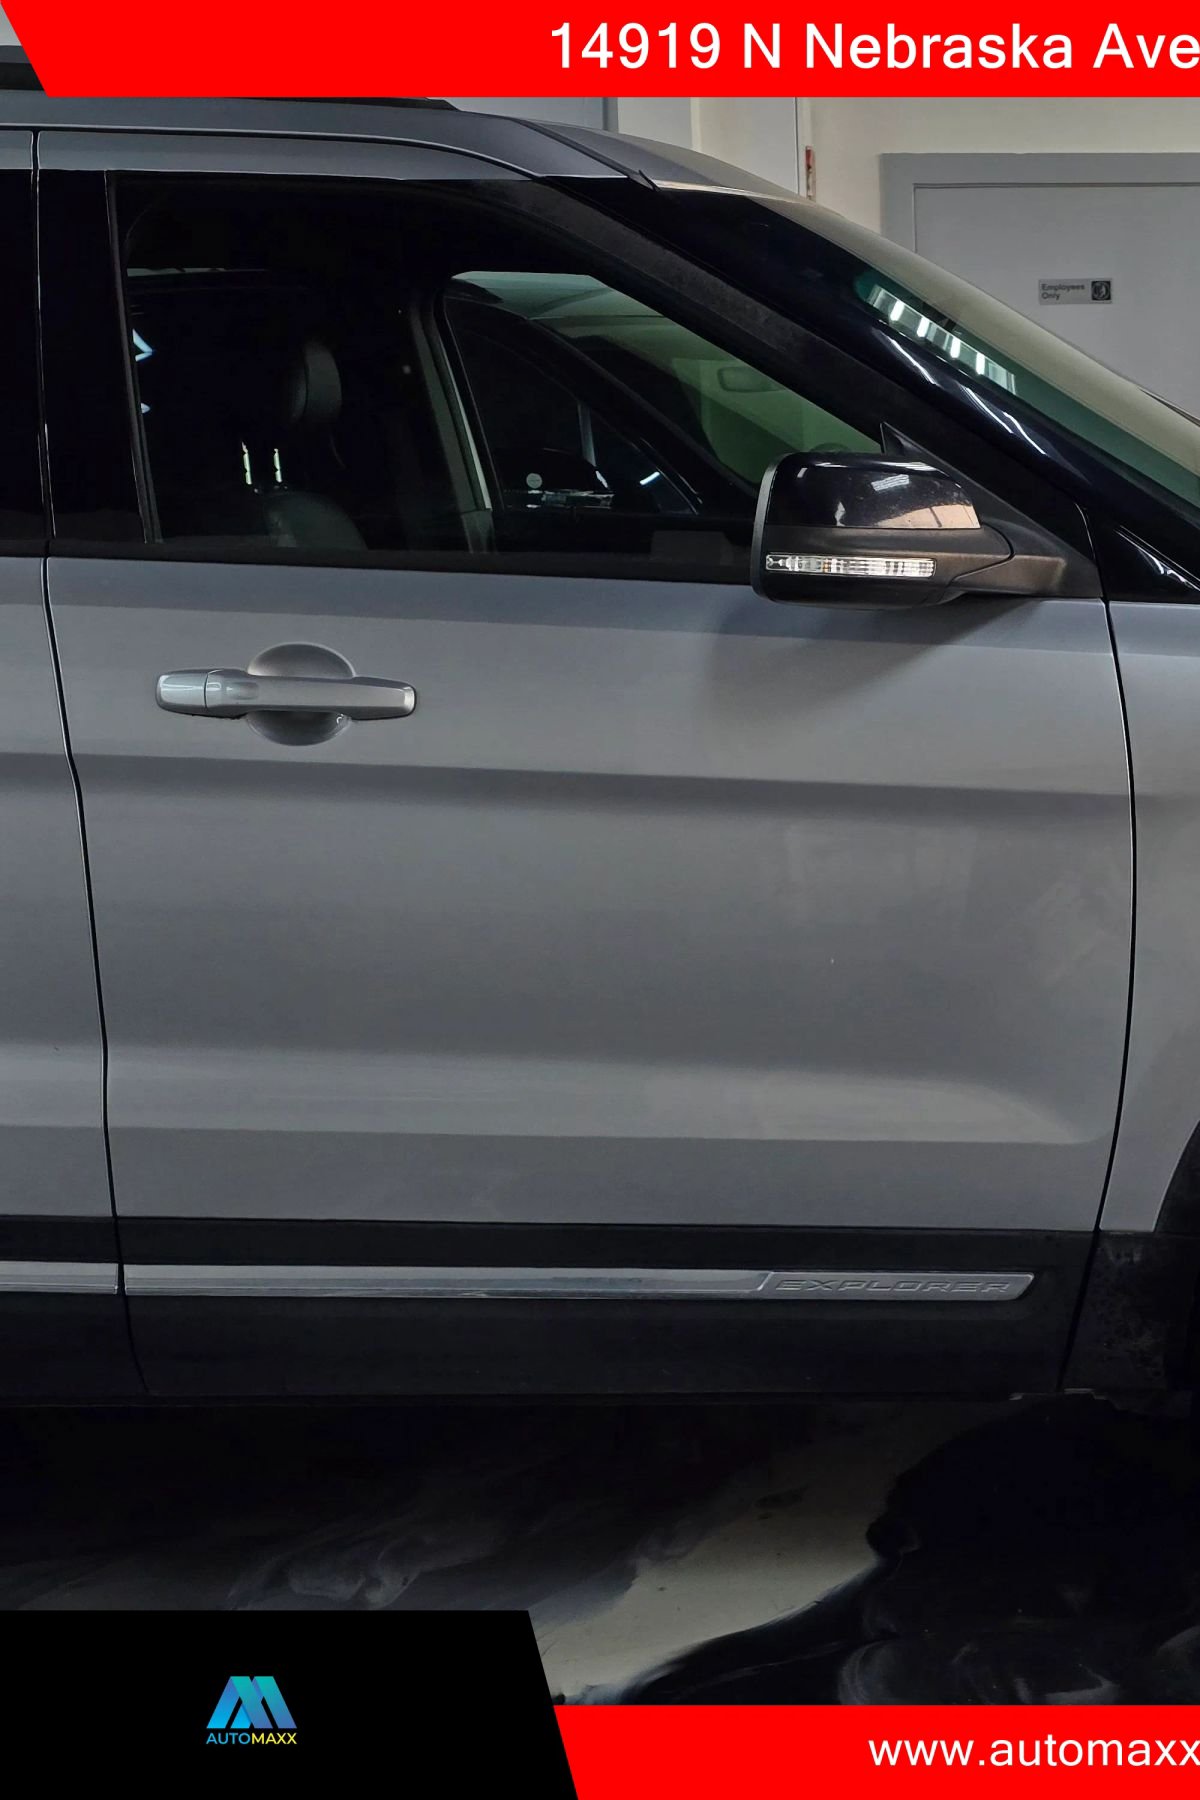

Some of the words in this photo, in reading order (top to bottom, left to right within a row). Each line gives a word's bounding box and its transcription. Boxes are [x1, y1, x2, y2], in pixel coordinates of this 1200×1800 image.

[1041, 283, 1085, 293] Employees
[1041, 292, 1060, 301] Only
[775, 1279, 1011, 1293] EXPLORER
